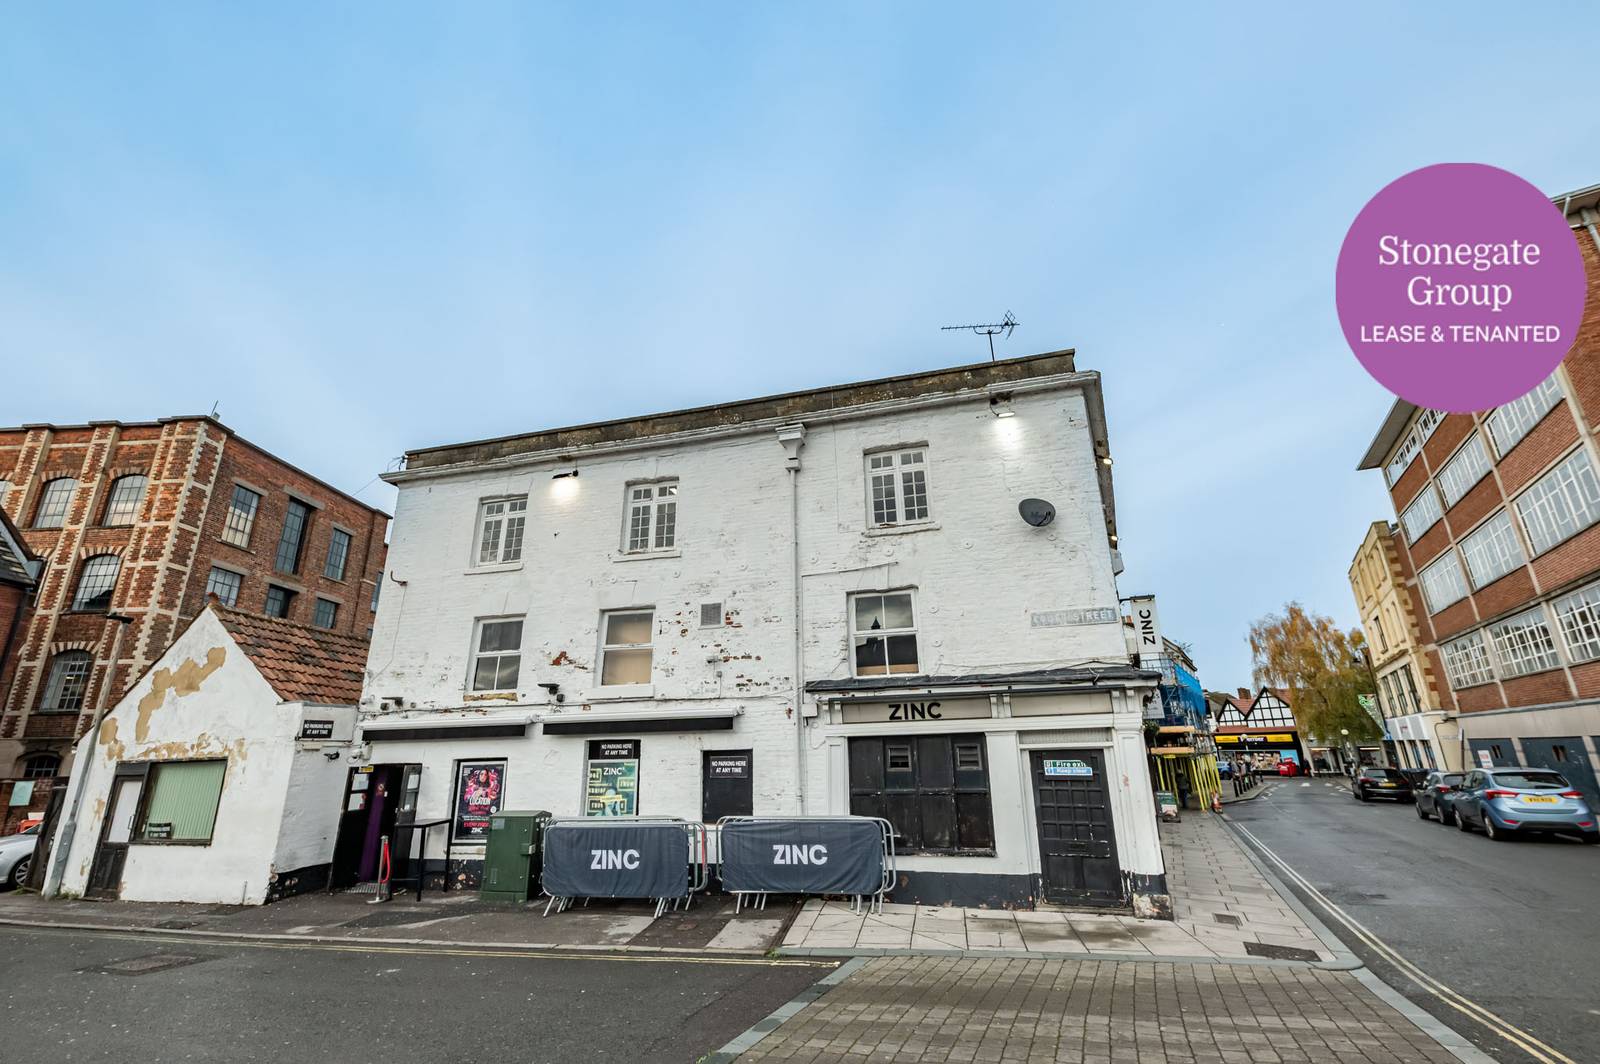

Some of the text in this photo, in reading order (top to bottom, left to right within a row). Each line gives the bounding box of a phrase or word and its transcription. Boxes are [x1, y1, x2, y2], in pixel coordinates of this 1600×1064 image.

[1071, 609, 1115, 623] STREET
[1139, 609, 1156, 645] ZINC
[888, 702, 942, 720] ZINC
[603, 767, 623, 776] ZINC
[590, 848, 640, 870] ZINC
[772, 844, 828, 866] ZINC
